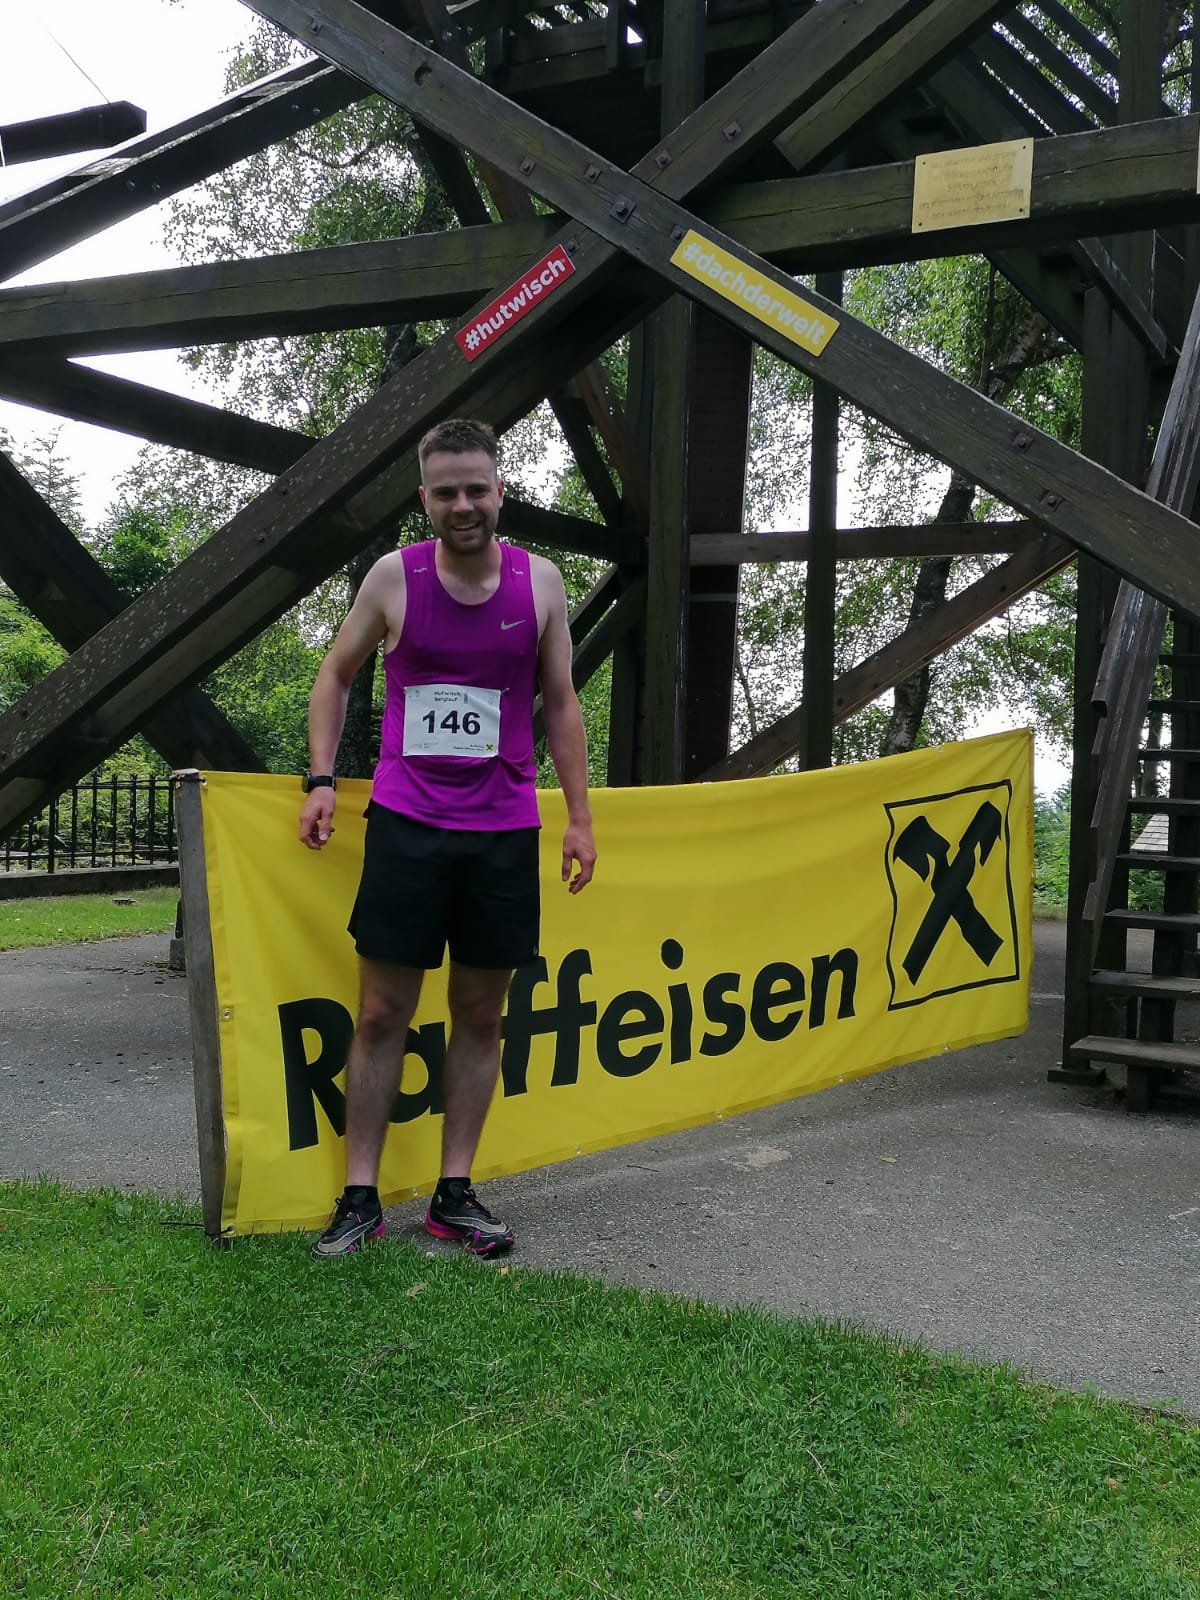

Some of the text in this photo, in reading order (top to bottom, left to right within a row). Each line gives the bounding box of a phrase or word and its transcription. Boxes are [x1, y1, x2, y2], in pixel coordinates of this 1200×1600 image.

[465, 259, 566, 350] #hutwisch
[681, 242, 826, 346] #dachderwelt
[422, 710, 481, 735] 146
[278, 938, 859, 1151] Raffeisen
